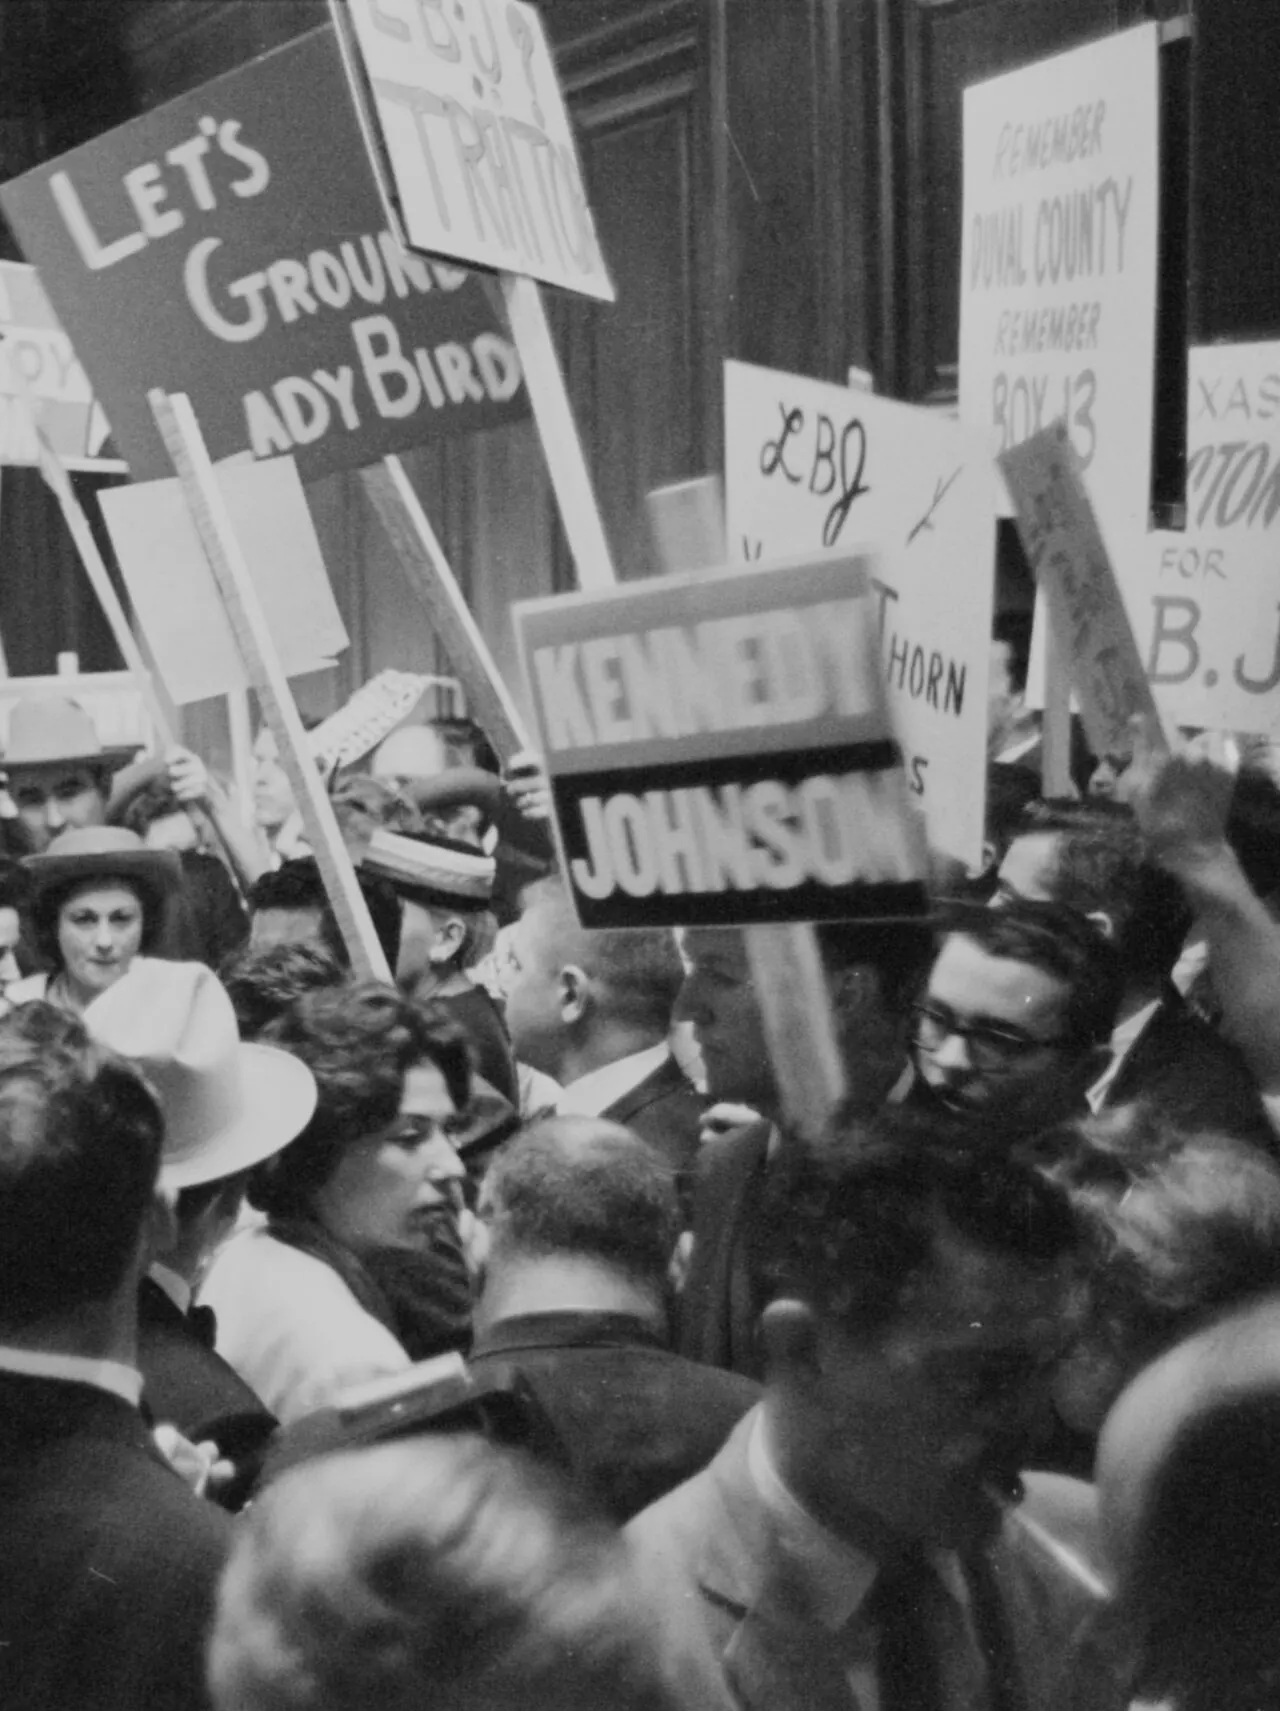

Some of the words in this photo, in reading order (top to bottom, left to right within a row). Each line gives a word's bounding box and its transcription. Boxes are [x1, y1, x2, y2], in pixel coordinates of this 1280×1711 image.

[48, 115, 270, 271] LET'S
[993, 99, 1107, 180] REMEMBER
[1033, 175, 1133, 288] COUNTY
[351, 314, 524, 420] BIRD
[993, 301, 1102, 356] REMEMBER
[760, 401, 870, 548] LBJ
[1159, 547, 1227, 581] FOR
[571, 768, 920, 899] JOHNSON
